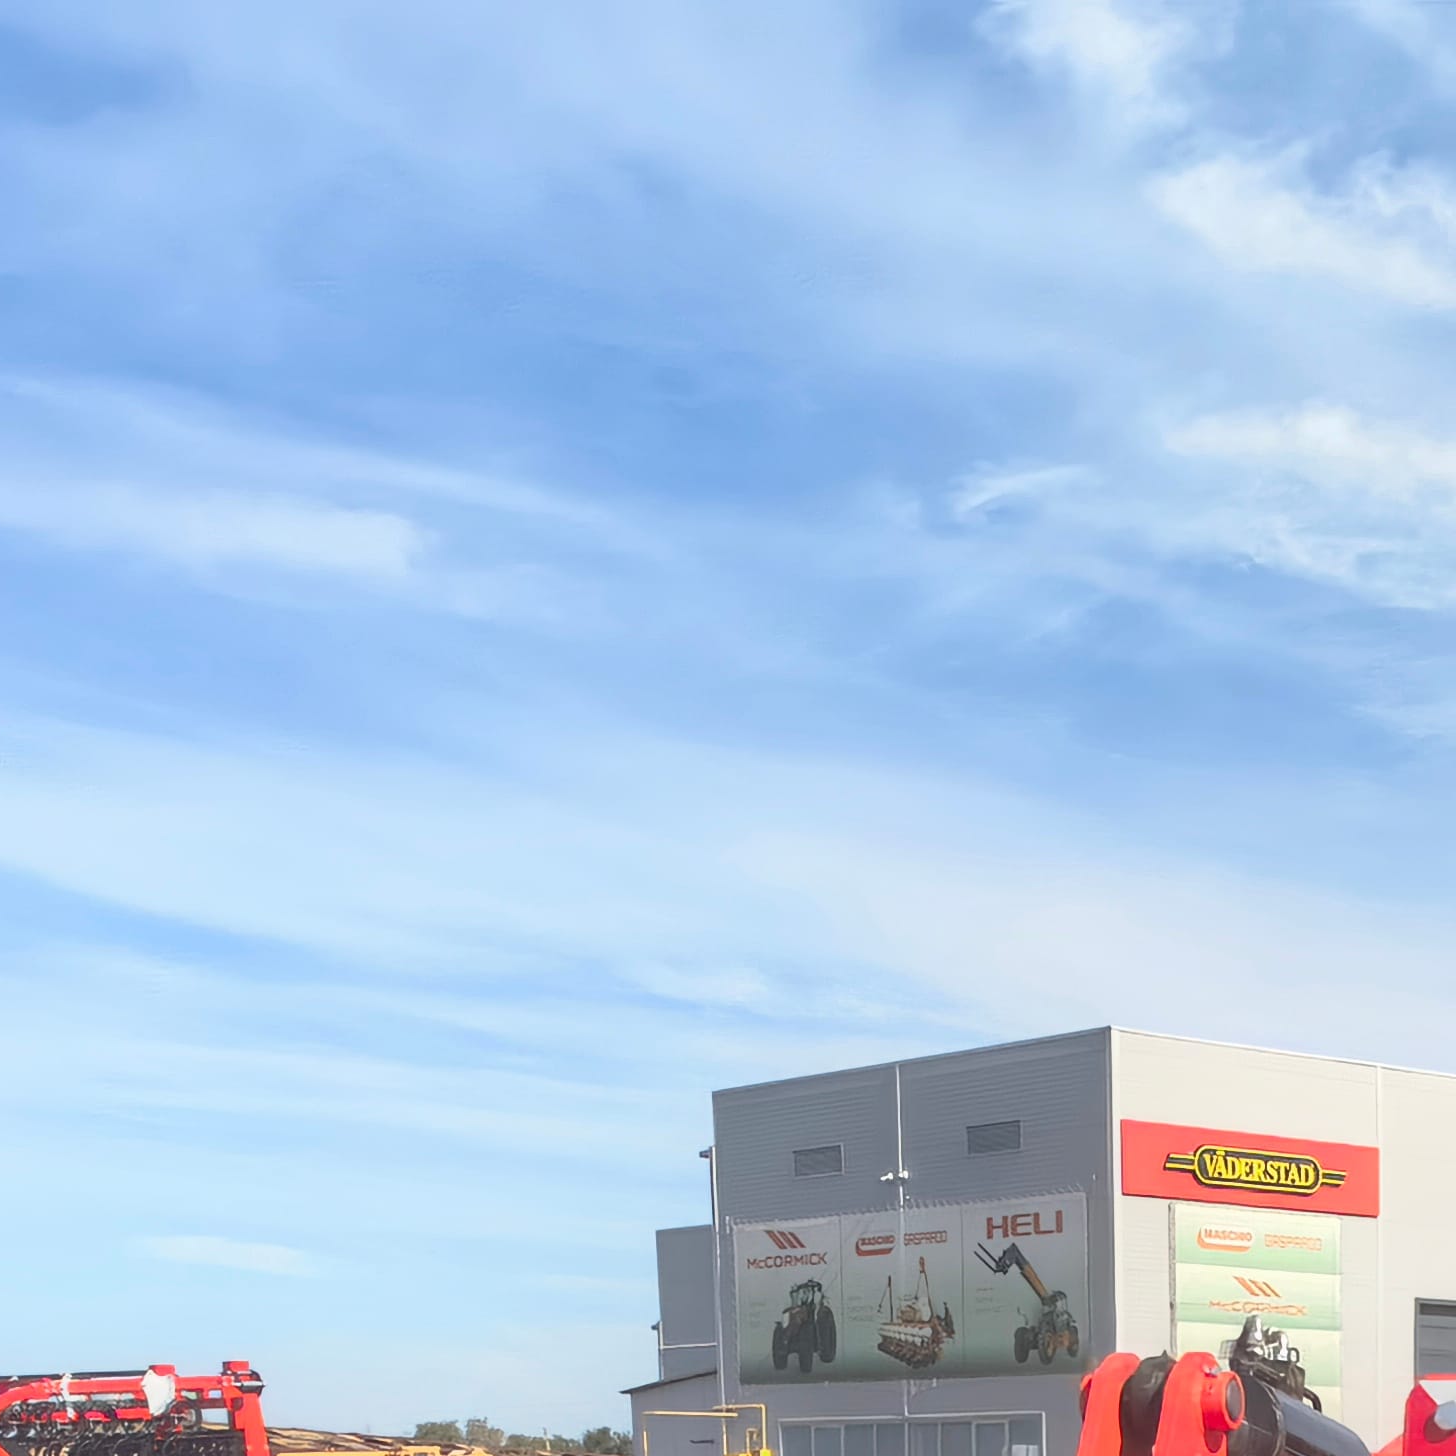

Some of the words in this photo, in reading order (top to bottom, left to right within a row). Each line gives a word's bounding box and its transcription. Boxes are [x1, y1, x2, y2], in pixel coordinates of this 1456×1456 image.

[1203, 1149, 1315, 1187] VÄDERSTAD
[986, 1210, 1063, 1239] HELI
[746, 1252, 828, 1270] McCORMICK
